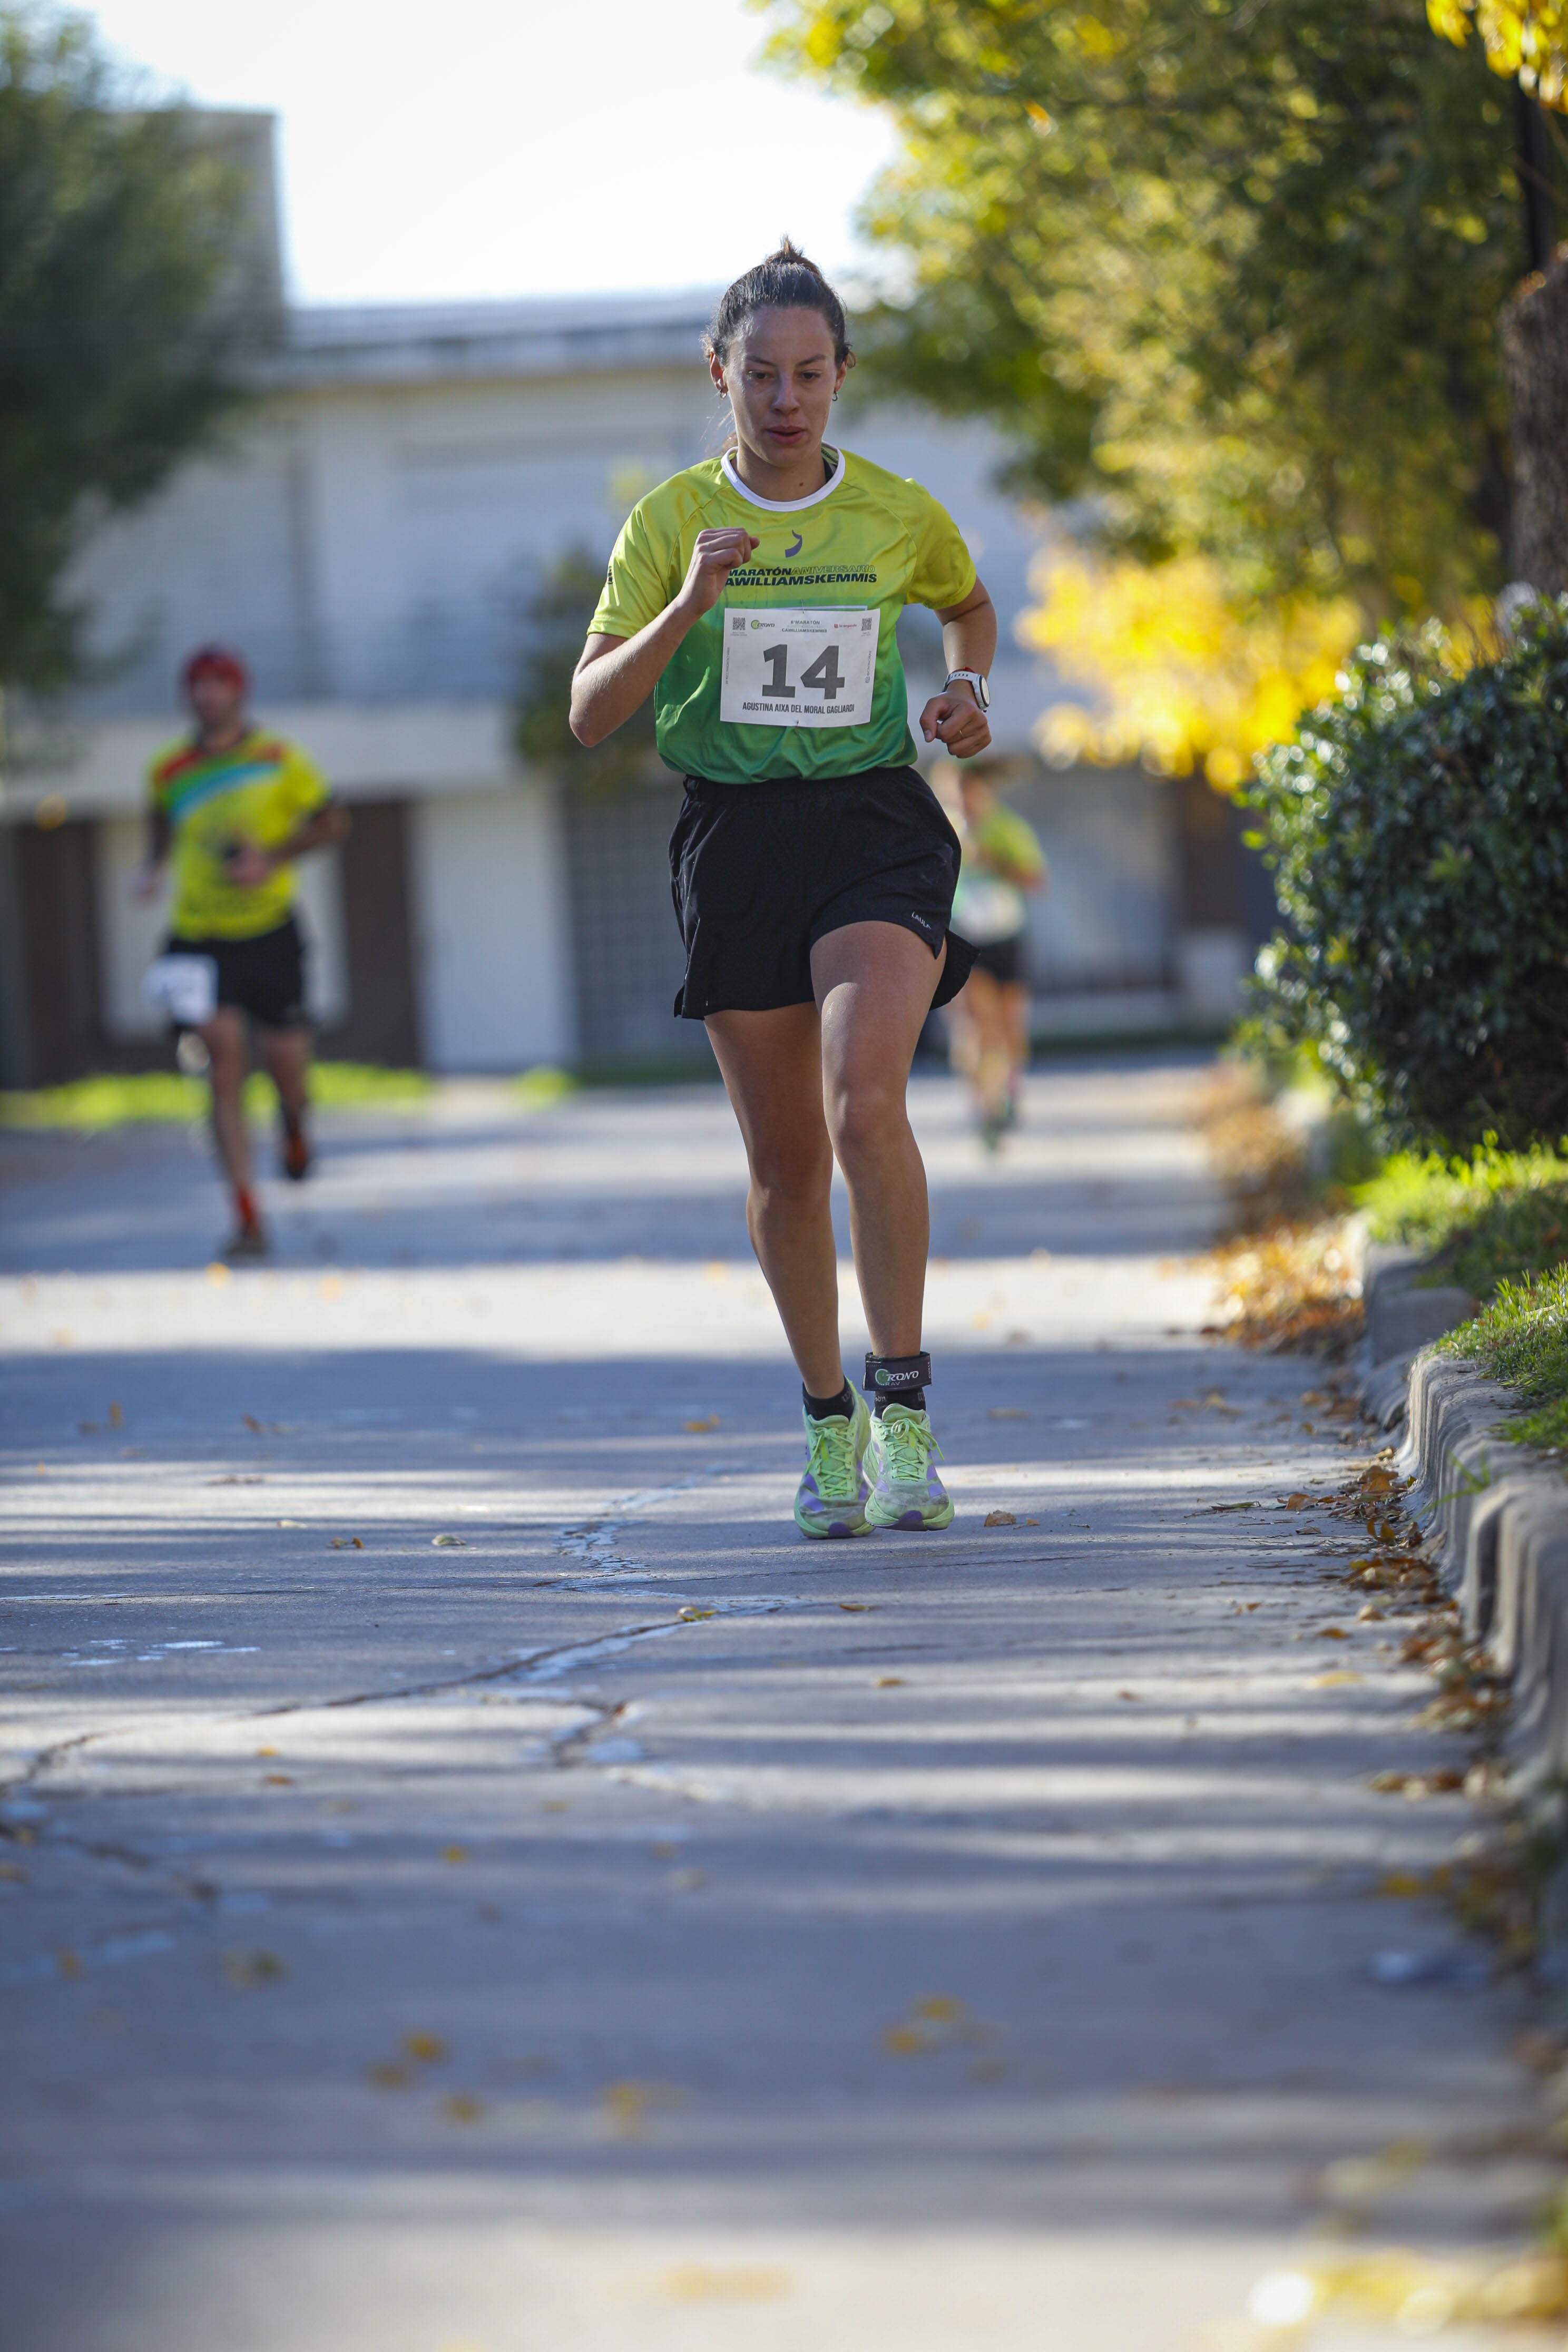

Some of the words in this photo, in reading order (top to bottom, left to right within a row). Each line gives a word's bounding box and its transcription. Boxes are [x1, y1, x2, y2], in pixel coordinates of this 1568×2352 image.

[725, 573, 877, 586] AWILLIAMSKEMMIS
[762, 644, 845, 700] 14
[742, 702, 773, 711] AGUSTINA
[791, 704, 802, 713] DEL
[804, 705, 825, 714] MORAL
[827, 703, 855, 714] GAGLIARDI
